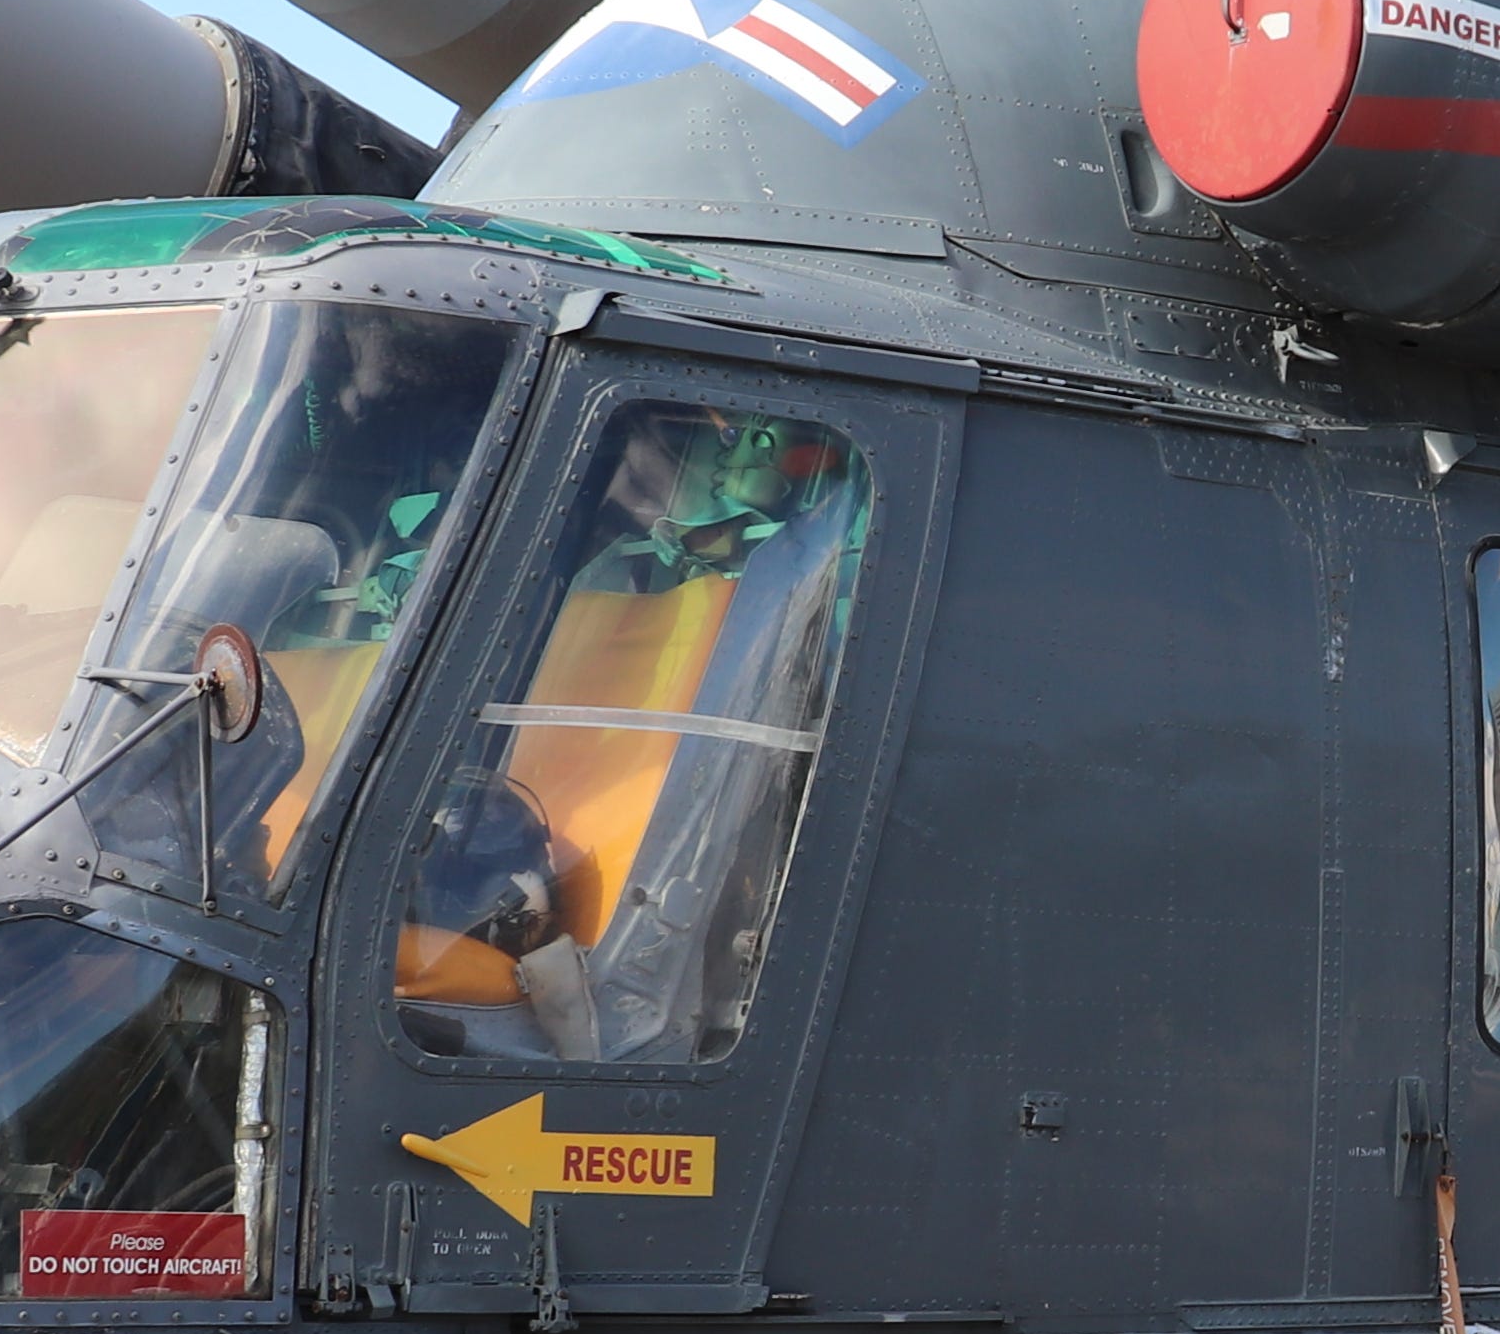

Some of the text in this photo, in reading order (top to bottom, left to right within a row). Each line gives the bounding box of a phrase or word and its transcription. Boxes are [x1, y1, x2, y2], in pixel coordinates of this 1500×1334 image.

[562, 1144, 693, 1186] RESCUE
[109, 1233, 165, 1252] Please
[432, 1243, 449, 1255] TO
[29, 1256, 241, 1275] DO NOT TOUCH AIRCRAFT!
